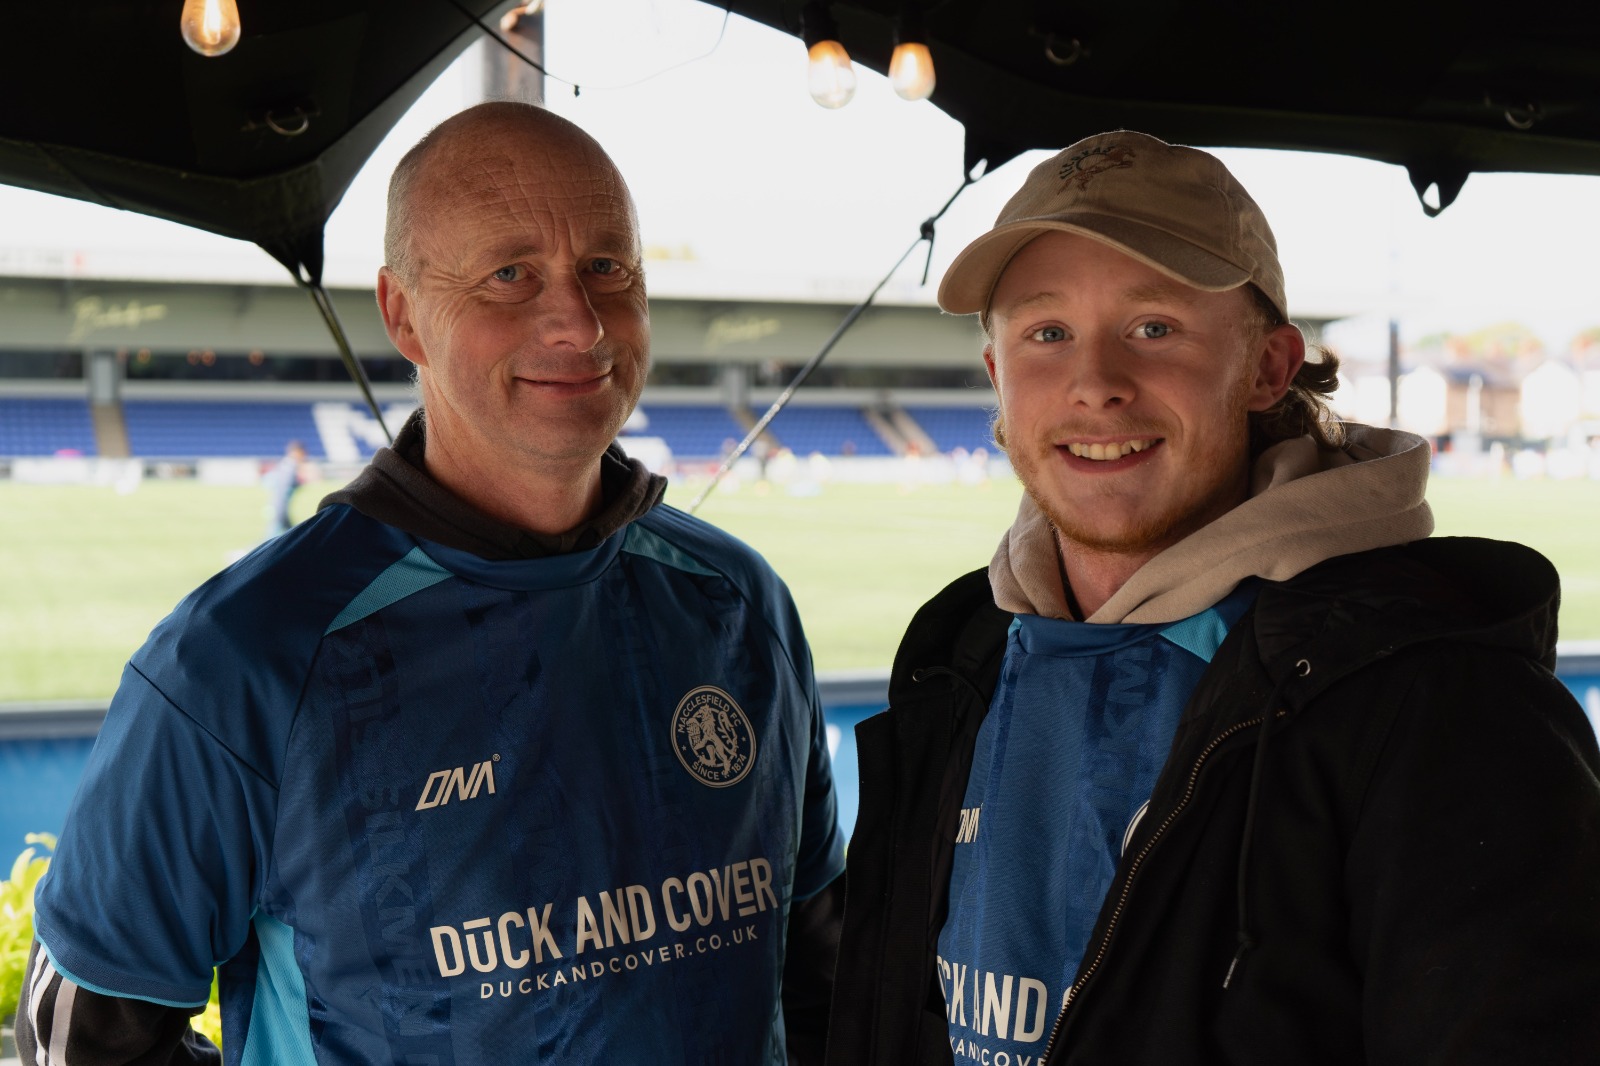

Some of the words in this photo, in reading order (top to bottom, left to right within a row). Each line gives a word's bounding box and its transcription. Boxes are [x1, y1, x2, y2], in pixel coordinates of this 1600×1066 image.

[678, 694, 730, 733] MACCLESFIELD
[730, 712, 742, 727] FC
[692, 761, 720, 780] SINCE
[731, 753, 747, 774] 1874
[576, 884, 657, 954] AND
[661, 857, 778, 932] COVER
[480, 924, 758, 999] DUCKANDCOVER.CO.UK
[973, 969, 1048, 1043] AND
